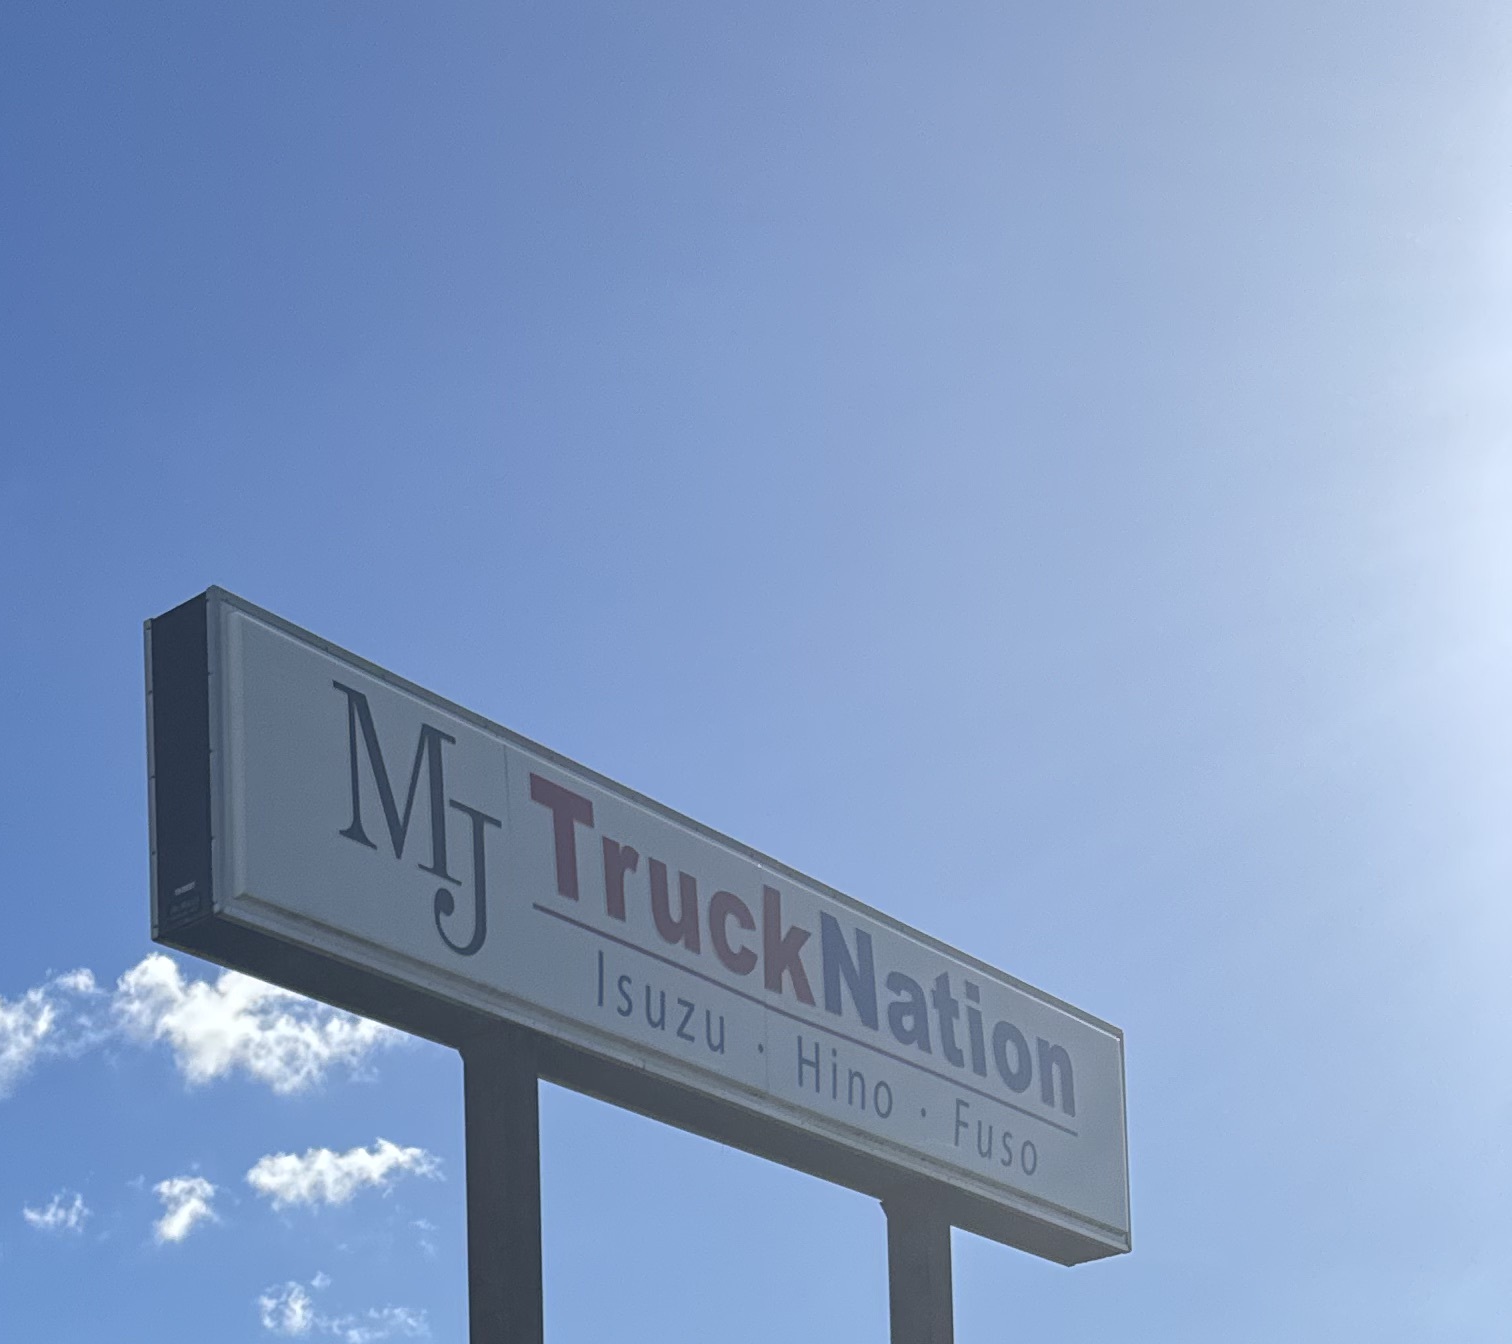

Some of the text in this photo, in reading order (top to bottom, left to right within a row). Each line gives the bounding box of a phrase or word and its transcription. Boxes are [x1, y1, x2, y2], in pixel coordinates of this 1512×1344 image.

[332, 679, 1077, 1118] MJ TruckNation
[596, 949, 1038, 1176] Isuzu Hino Fuso
